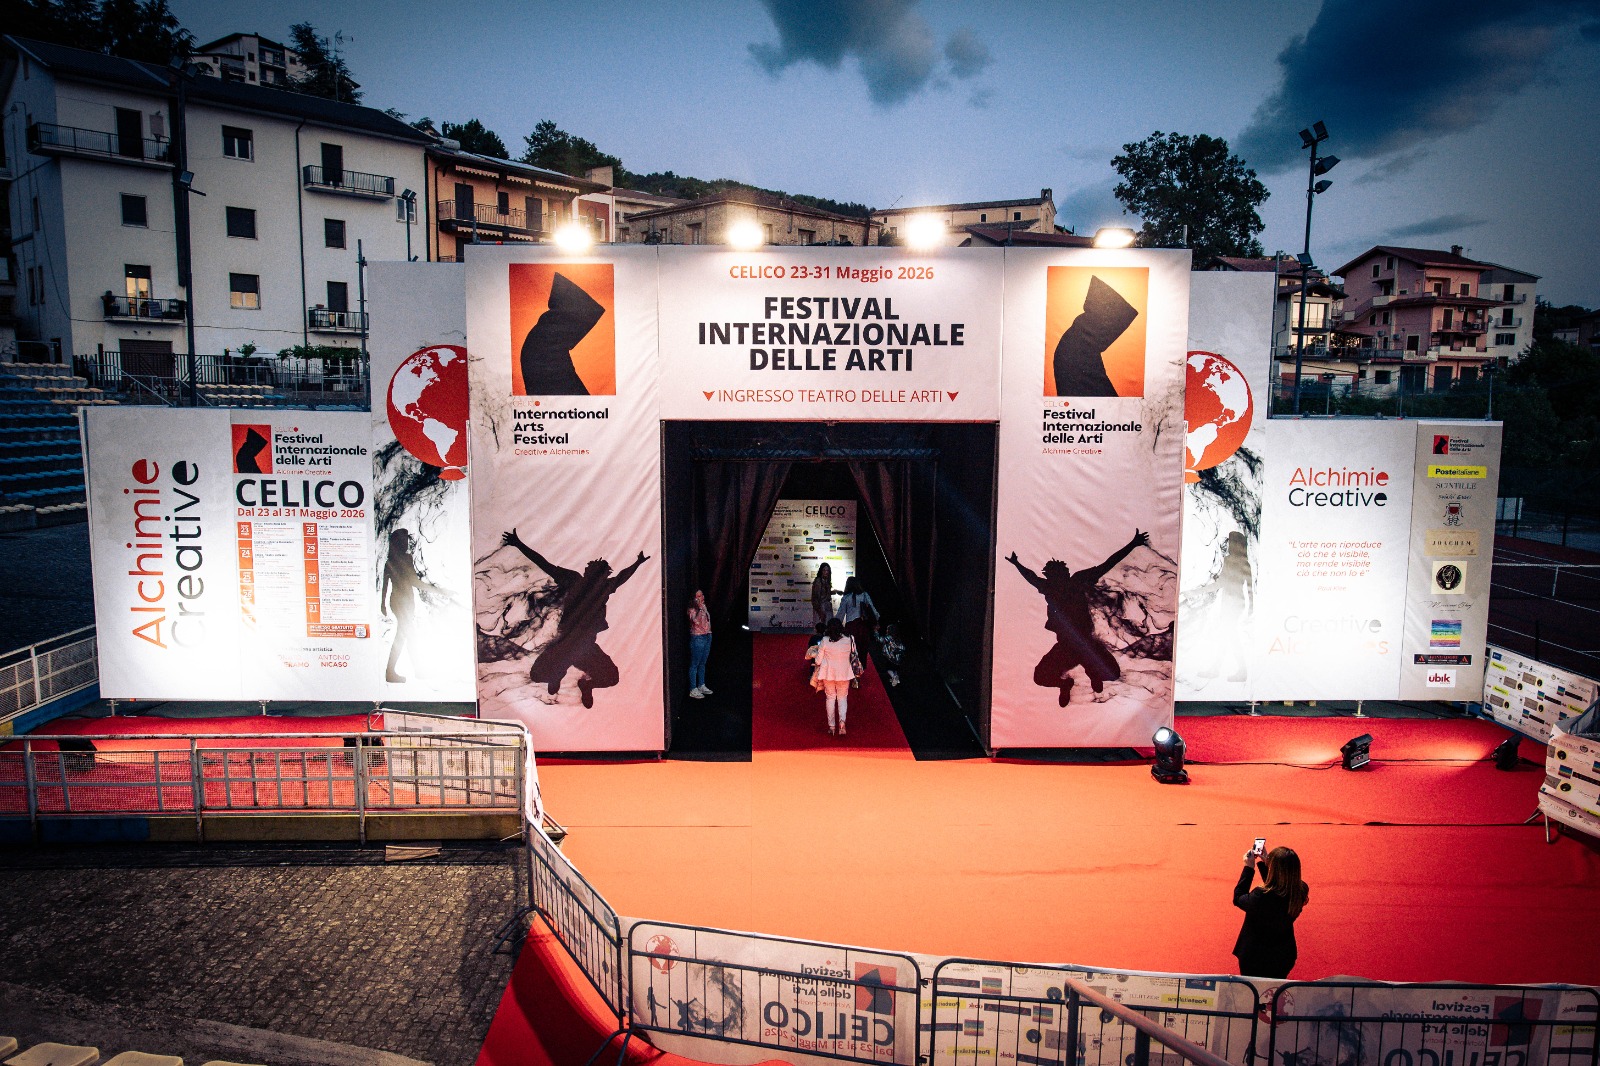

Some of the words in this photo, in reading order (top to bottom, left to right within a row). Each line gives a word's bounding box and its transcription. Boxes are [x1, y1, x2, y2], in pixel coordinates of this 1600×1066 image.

[730, 266, 786, 278] CELICO
[790, 266, 831, 279] 23-31
[836, 266, 892, 282] Maggio
[898, 267, 934, 280] 2026
[764, 296, 900, 320] FESTIVAL
[699, 322, 964, 346] INTERNAZIONALE
[750, 348, 836, 370] DELLE
[845, 348, 912, 372] ARTI
[718, 390, 794, 402] INGRESSO
[798, 390, 857, 402] TEATRO
[862, 390, 905, 402] DELLE
[910, 390, 942, 402] ARTI
[514, 408, 608, 420] International
[1044, 409, 1095, 420] Festival
[514, 422, 544, 432] Arts
[1043, 421, 1142, 432] Internazionale
[275, 434, 323, 443] Festival
[514, 433, 568, 444] Festival
[1042, 433, 1074, 444] delle
[1078, 433, 1103, 444] Arti
[275, 445, 367, 455] Internazionale
[276, 455, 305, 465] delle
[308, 456, 332, 465] Arti
[1289, 467, 1389, 486] Alchimie
[236, 479, 364, 508] CELICO
[1288, 488, 1387, 506] Creative
[237, 508, 254, 516] Dal
[258, 508, 270, 517] 23
[272, 508, 282, 517] al
[285, 509, 296, 517] 31
[300, 509, 338, 519] Maggio
[341, 510, 365, 518] 2026
[805, 506, 845, 515] CELICO
[1340, 541, 1382, 549] riproduce
[124, 459, 167, 649] Alchimie
[164, 460, 205, 648] Creative
[1429, 673, 1450, 682] ubik
